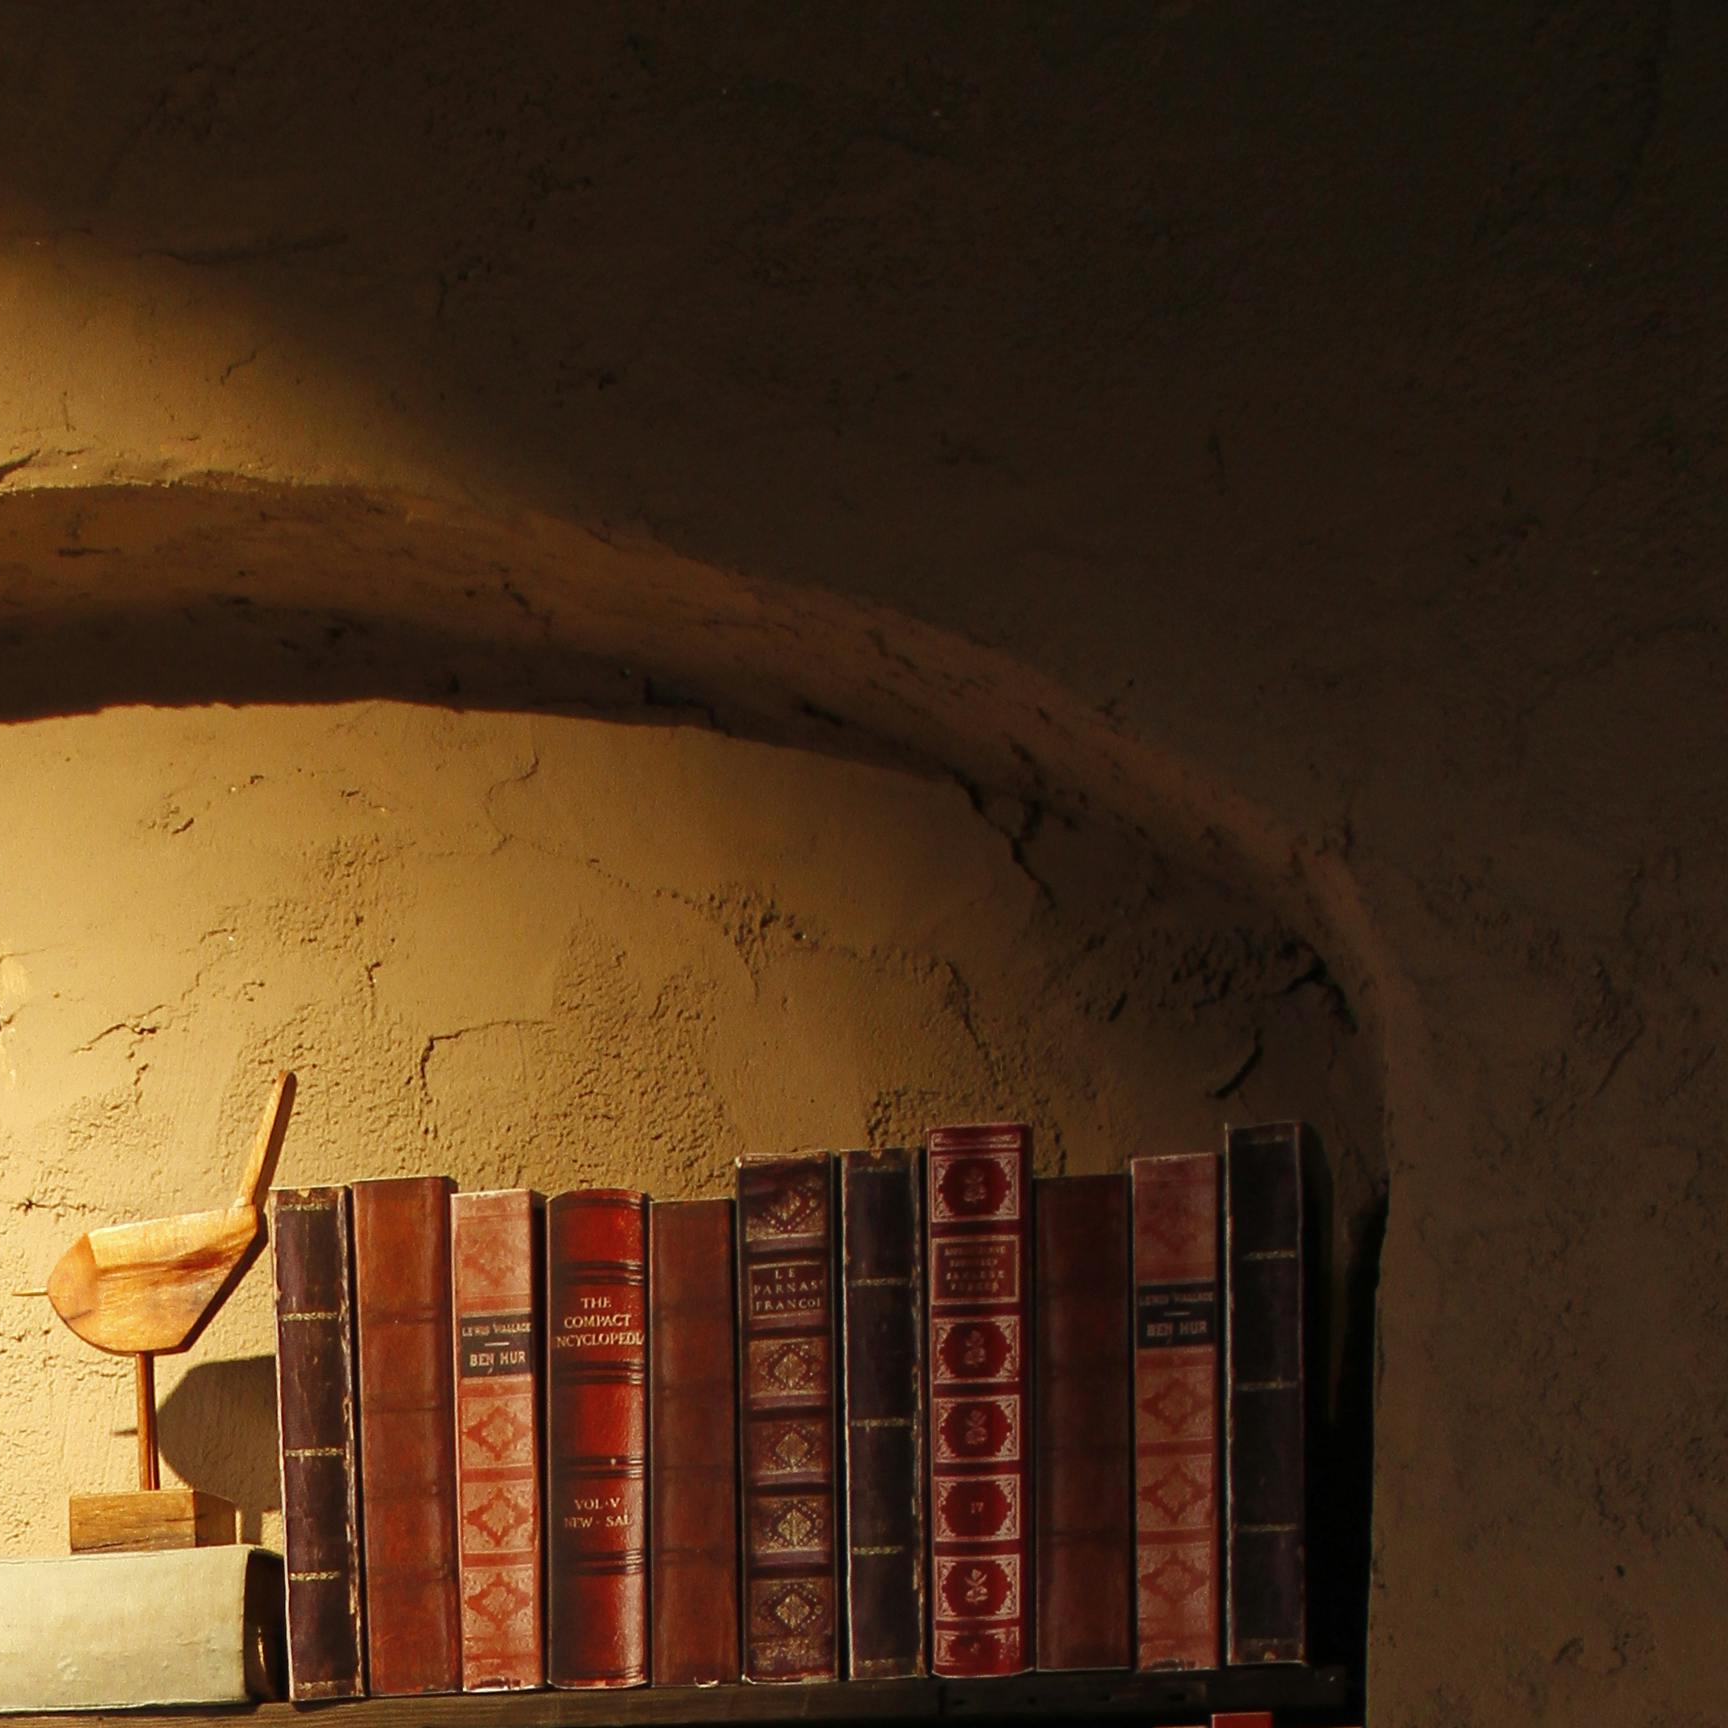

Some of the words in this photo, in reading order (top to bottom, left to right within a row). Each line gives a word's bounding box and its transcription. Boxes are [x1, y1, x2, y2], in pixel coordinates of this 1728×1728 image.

[775, 1267, 796, 1280] LE
[581, 1297, 612, 1309] THE
[564, 1313, 631, 1328] COMPACT
[469, 1353, 494, 1367] BEN
[500, 1351, 526, 1365] HUR
